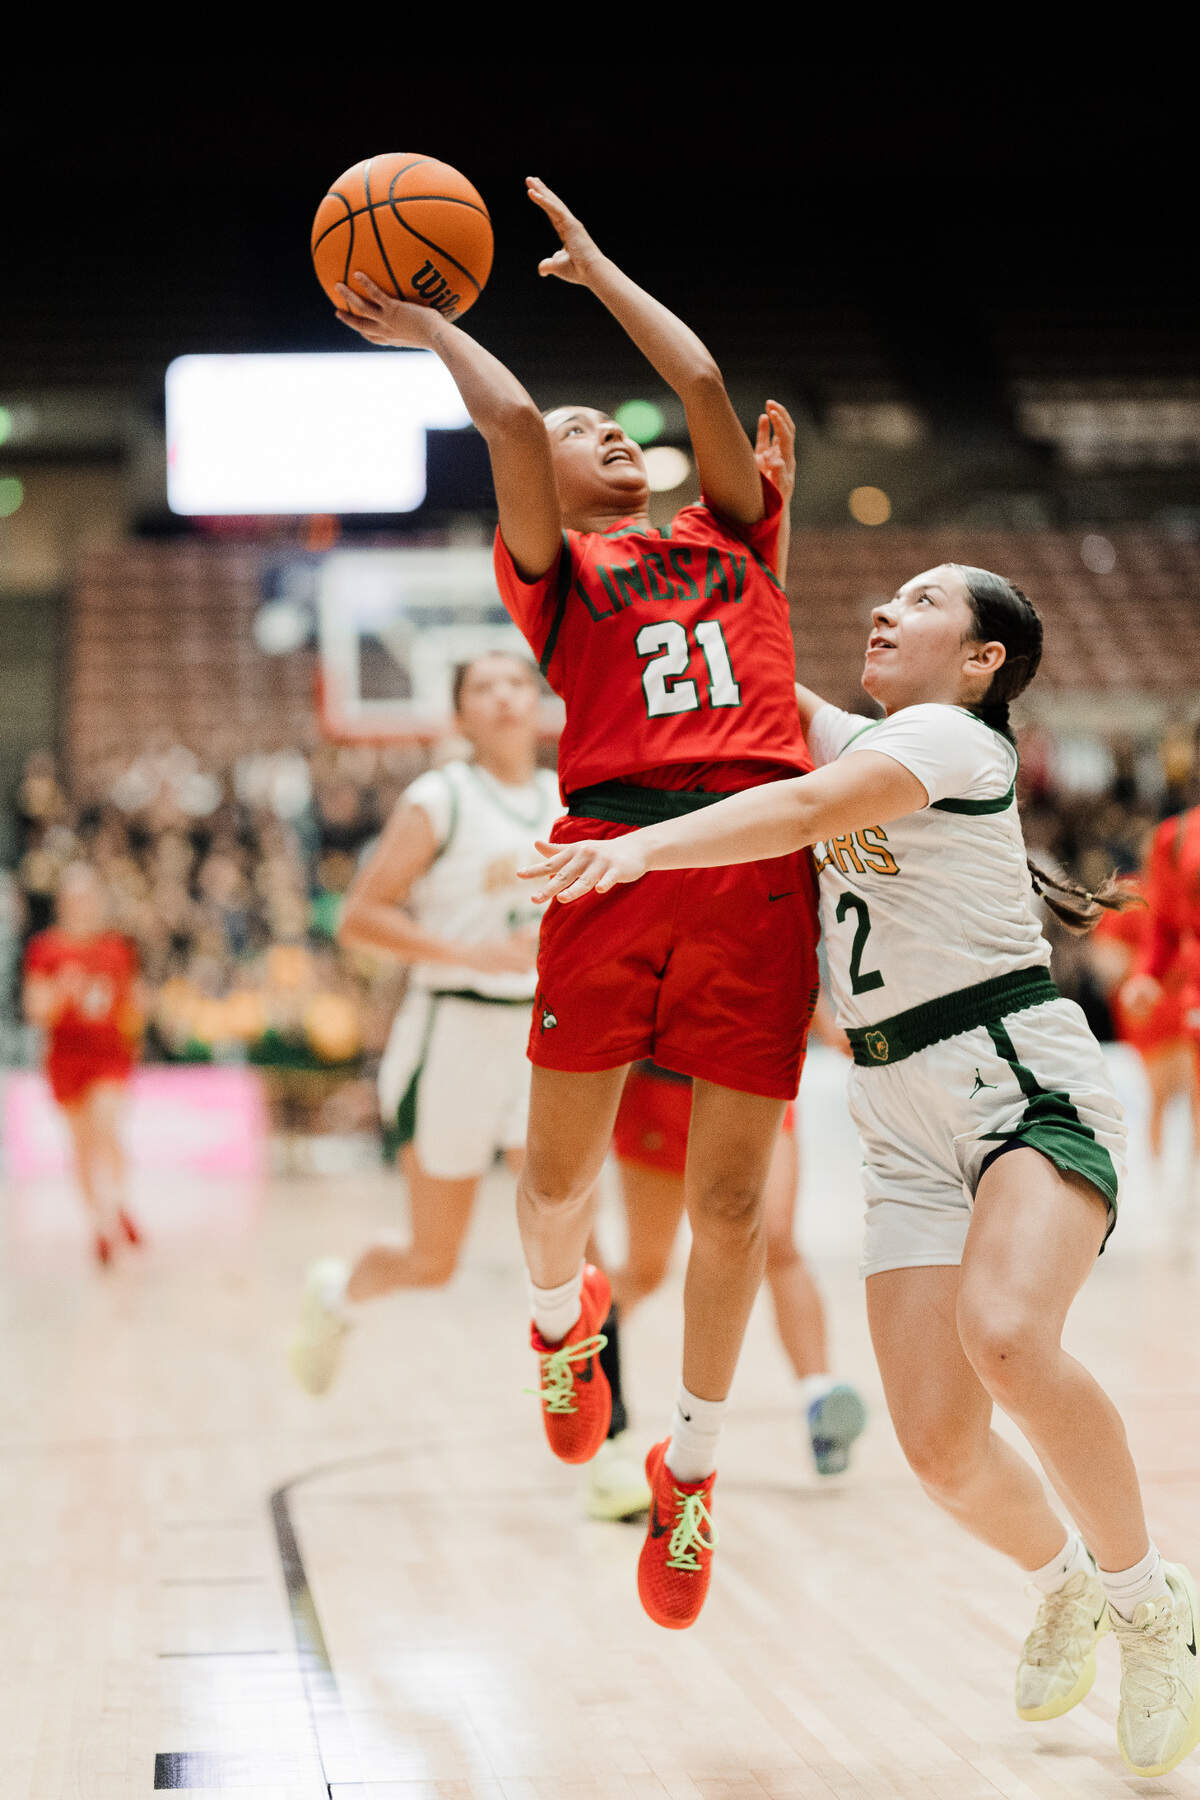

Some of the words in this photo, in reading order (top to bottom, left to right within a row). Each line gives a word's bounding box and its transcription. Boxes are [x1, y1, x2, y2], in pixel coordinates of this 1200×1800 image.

[575, 546, 746, 622] LINDSAY
[634, 619, 743, 720] 21
[835, 891, 885, 995] 2
